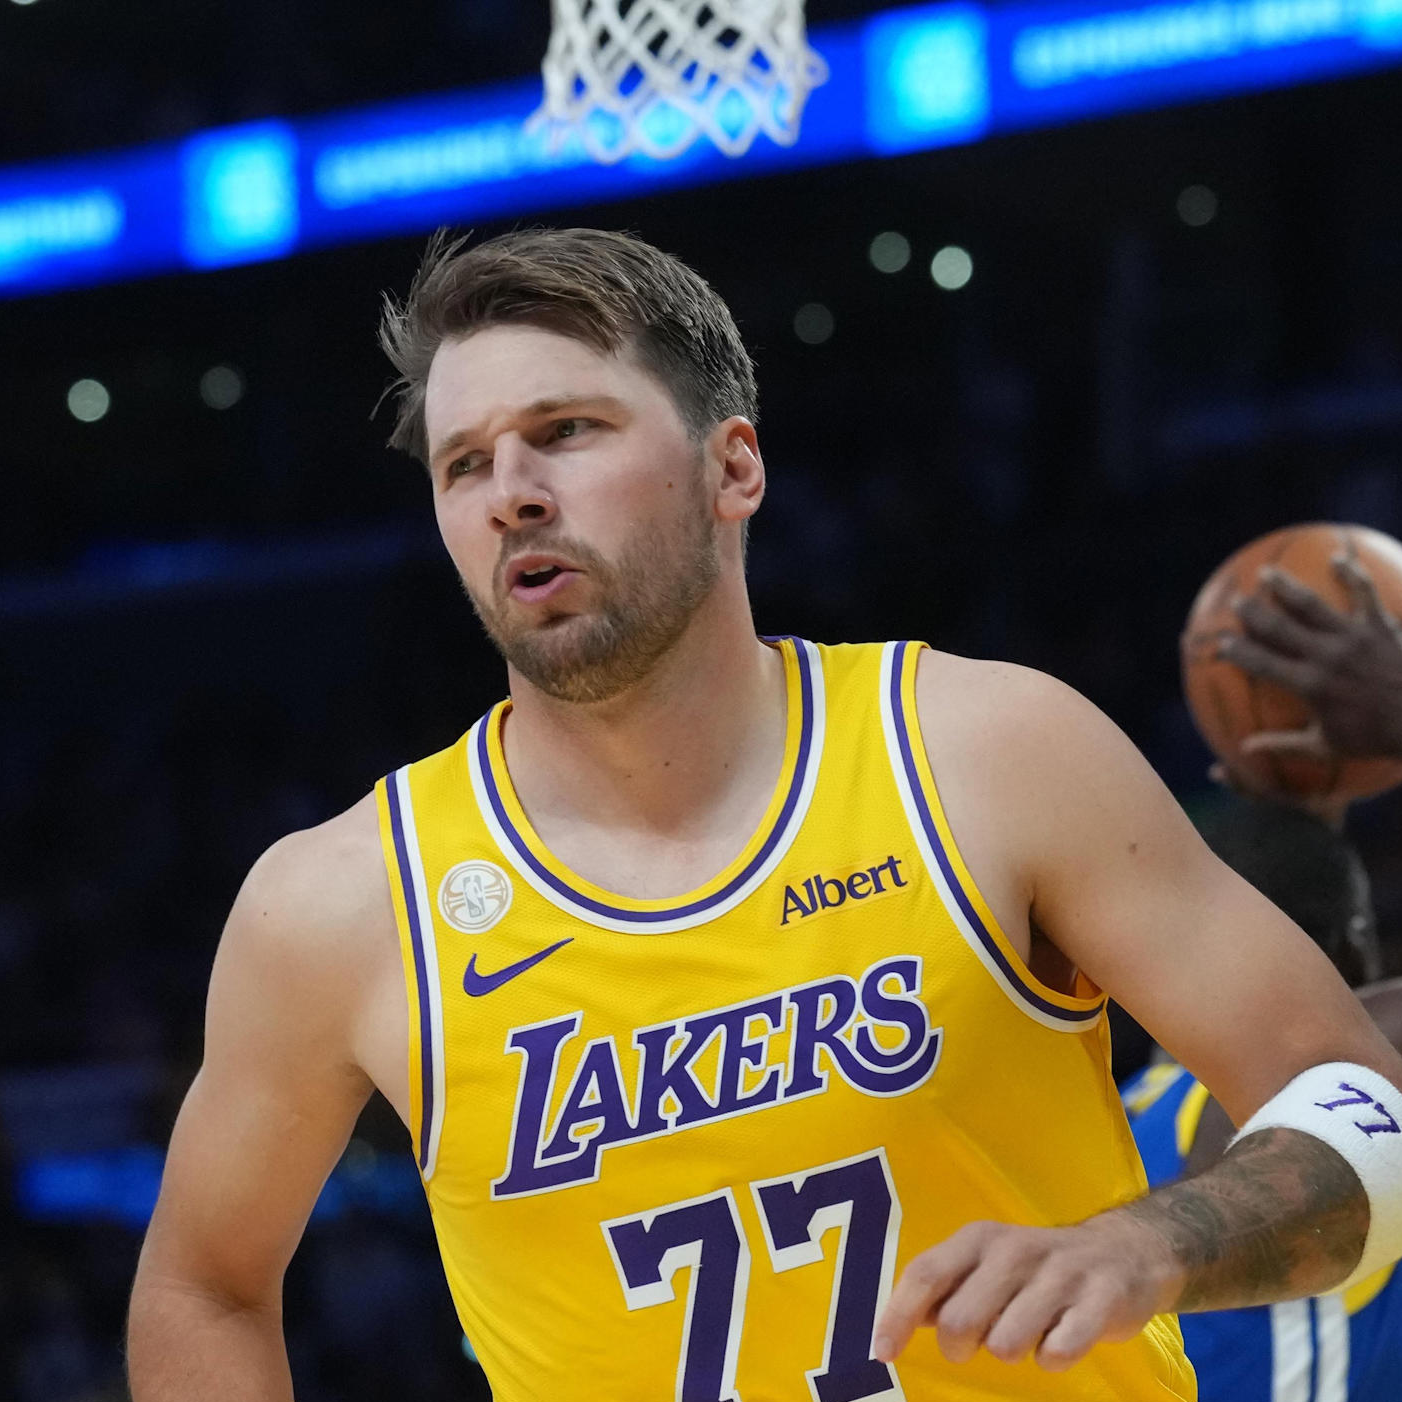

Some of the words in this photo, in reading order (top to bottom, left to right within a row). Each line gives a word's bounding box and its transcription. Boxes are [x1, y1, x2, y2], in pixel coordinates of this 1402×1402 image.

[779, 855, 909, 926] Albert
[490, 955, 944, 1201] LAKERS
[1314, 1082, 1402, 1140] 77
